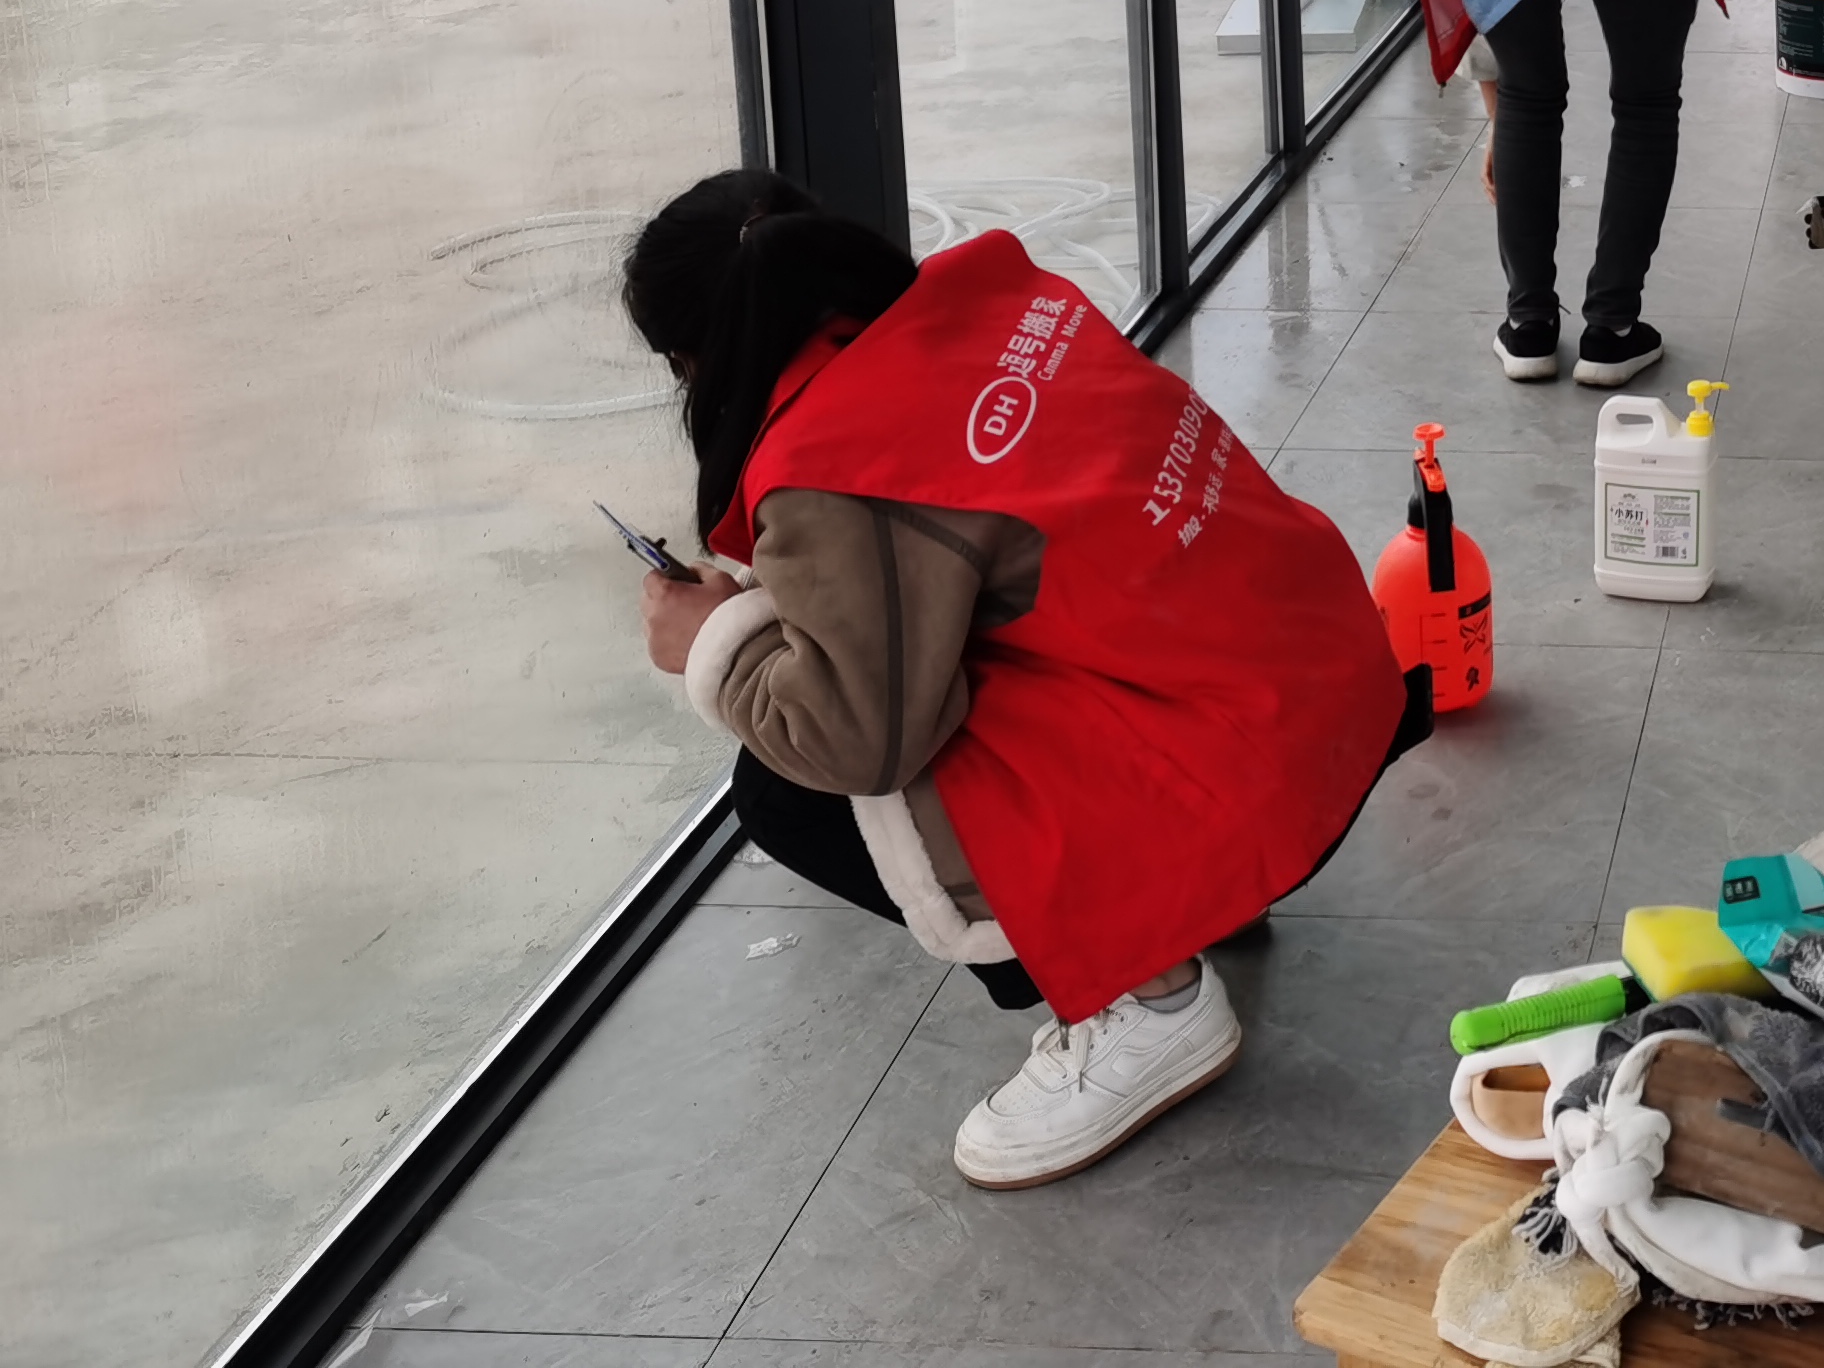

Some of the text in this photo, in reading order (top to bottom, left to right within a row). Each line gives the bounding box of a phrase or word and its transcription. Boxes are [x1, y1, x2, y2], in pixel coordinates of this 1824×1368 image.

[997, 296, 1068, 378] 逗号搬家
[1037, 304, 1088, 382] Comma Move
[983, 394, 1020, 436] DH
[1142, 389, 1208, 527] 153703090
[1614, 507, 1643, 520] 小苏打
